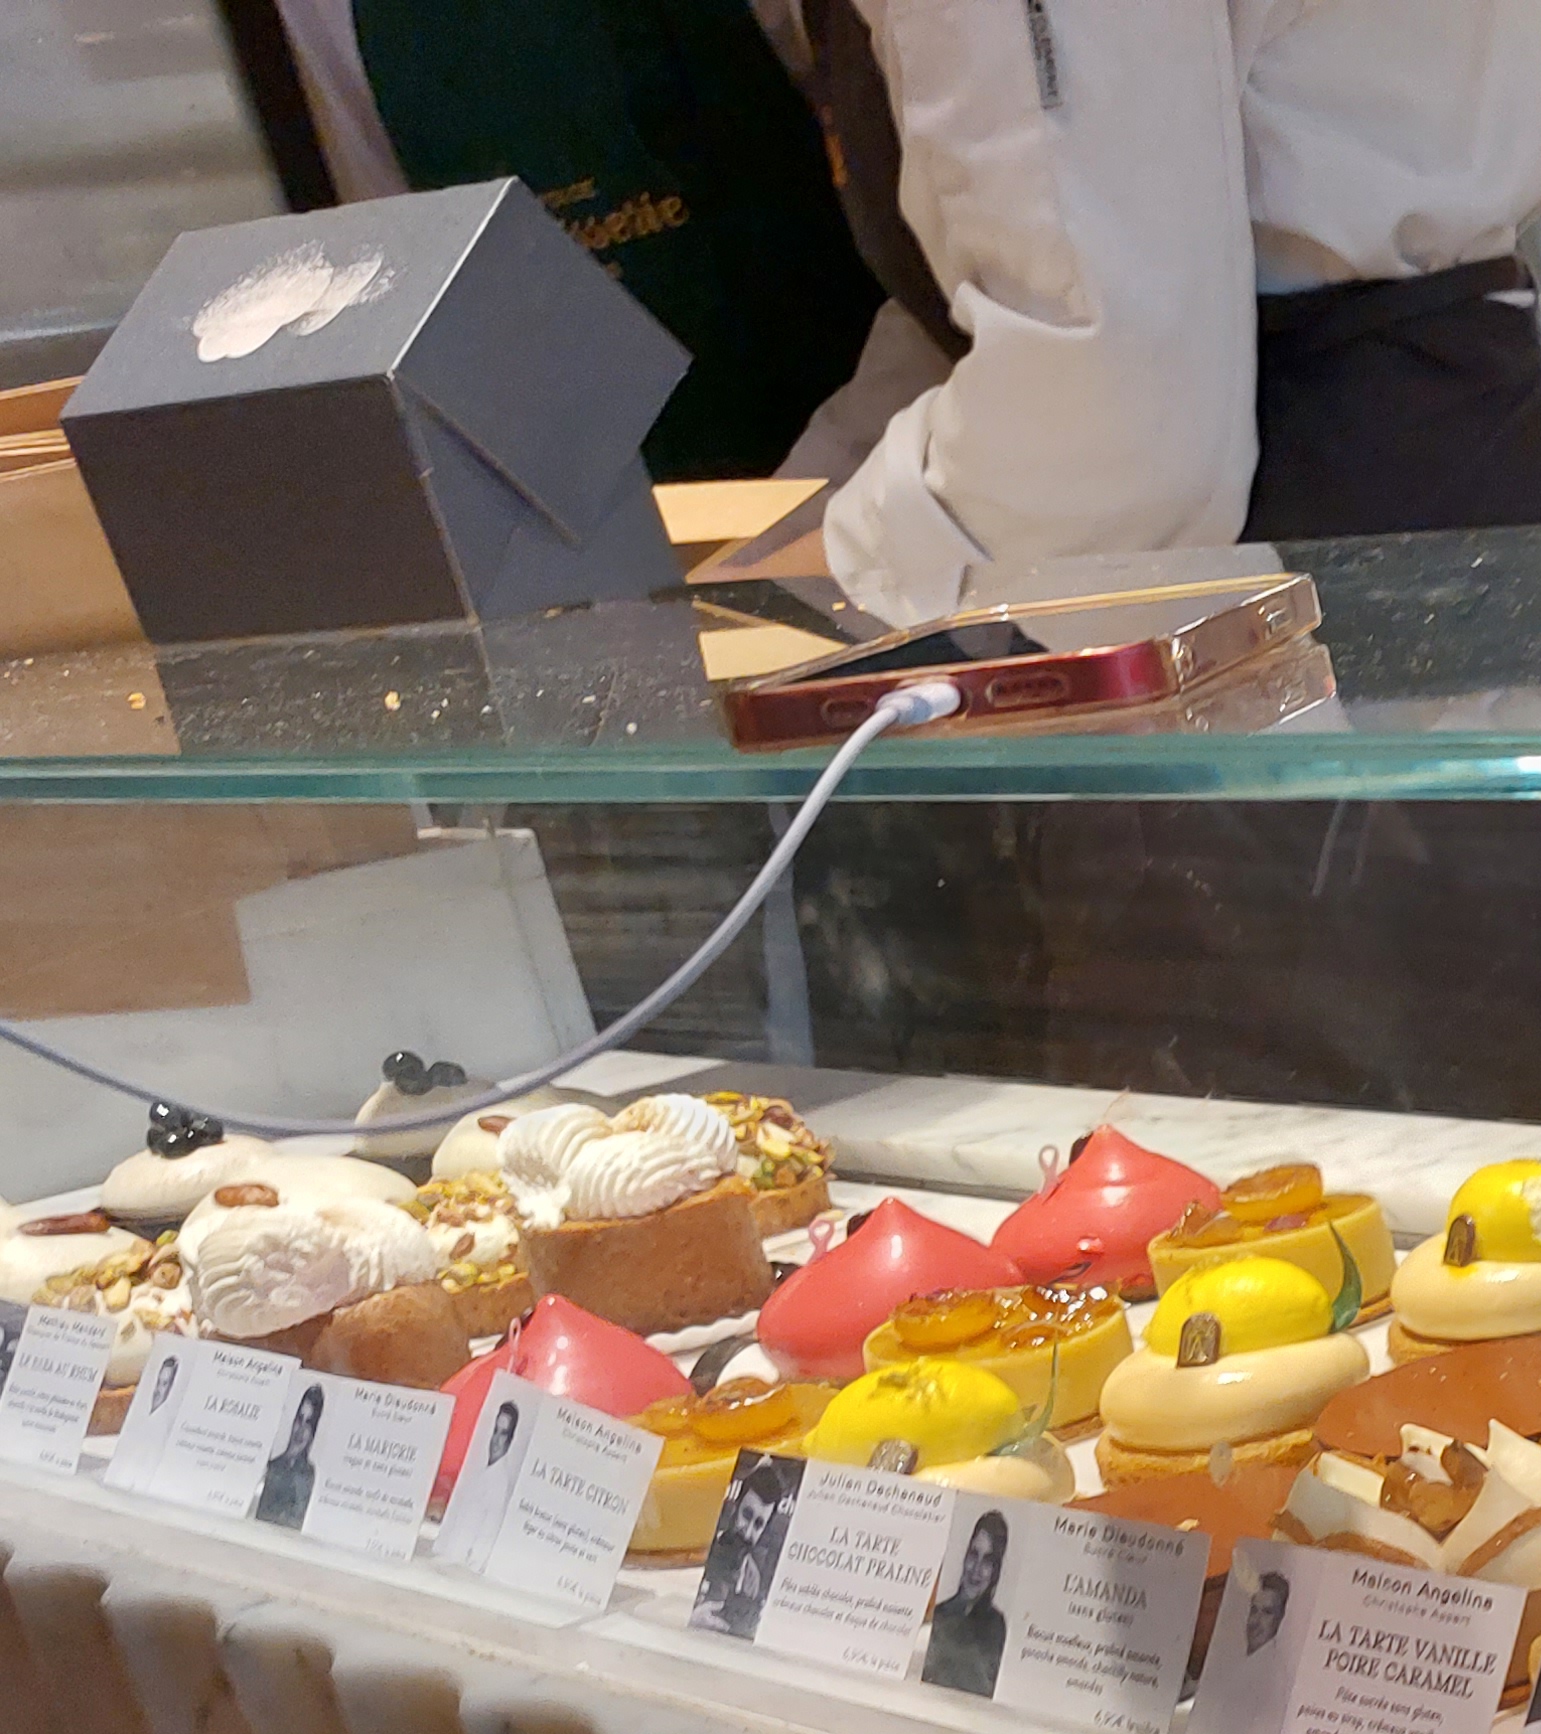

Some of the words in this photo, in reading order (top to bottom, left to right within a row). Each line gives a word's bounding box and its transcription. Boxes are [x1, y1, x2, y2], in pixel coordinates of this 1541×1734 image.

[347, 1432, 362, 1450] LA
[530, 1457, 547, 1480] LA
[549, 1466, 586, 1497] TARTE
[585, 1483, 630, 1515] CITRON
[820, 1471, 862, 1491] Julien
[866, 1480, 944, 1508] Dechenaud
[829, 1526, 849, 1546] LA
[855, 1530, 902, 1557] TARTE
[1054, 1516, 1097, 1539] Marie
[1101, 1524, 1186, 1558] Dieudonné
[789, 1542, 866, 1574] CHOCOLAT
[865, 1558, 932, 1587] PRALINÉ
[1062, 1573, 1147, 1611] L'AMANDA
[1352, 1569, 1412, 1595] Maison
[1416, 1581, 1493, 1611] Angelina
[1318, 1619, 1342, 1643] LA
[1349, 1625, 1410, 1657] TARTE
[1415, 1638, 1497, 1674] VANILLE
[1324, 1649, 1380, 1678] POIRE
[1384, 1661, 1474, 1700] CARAMEL
